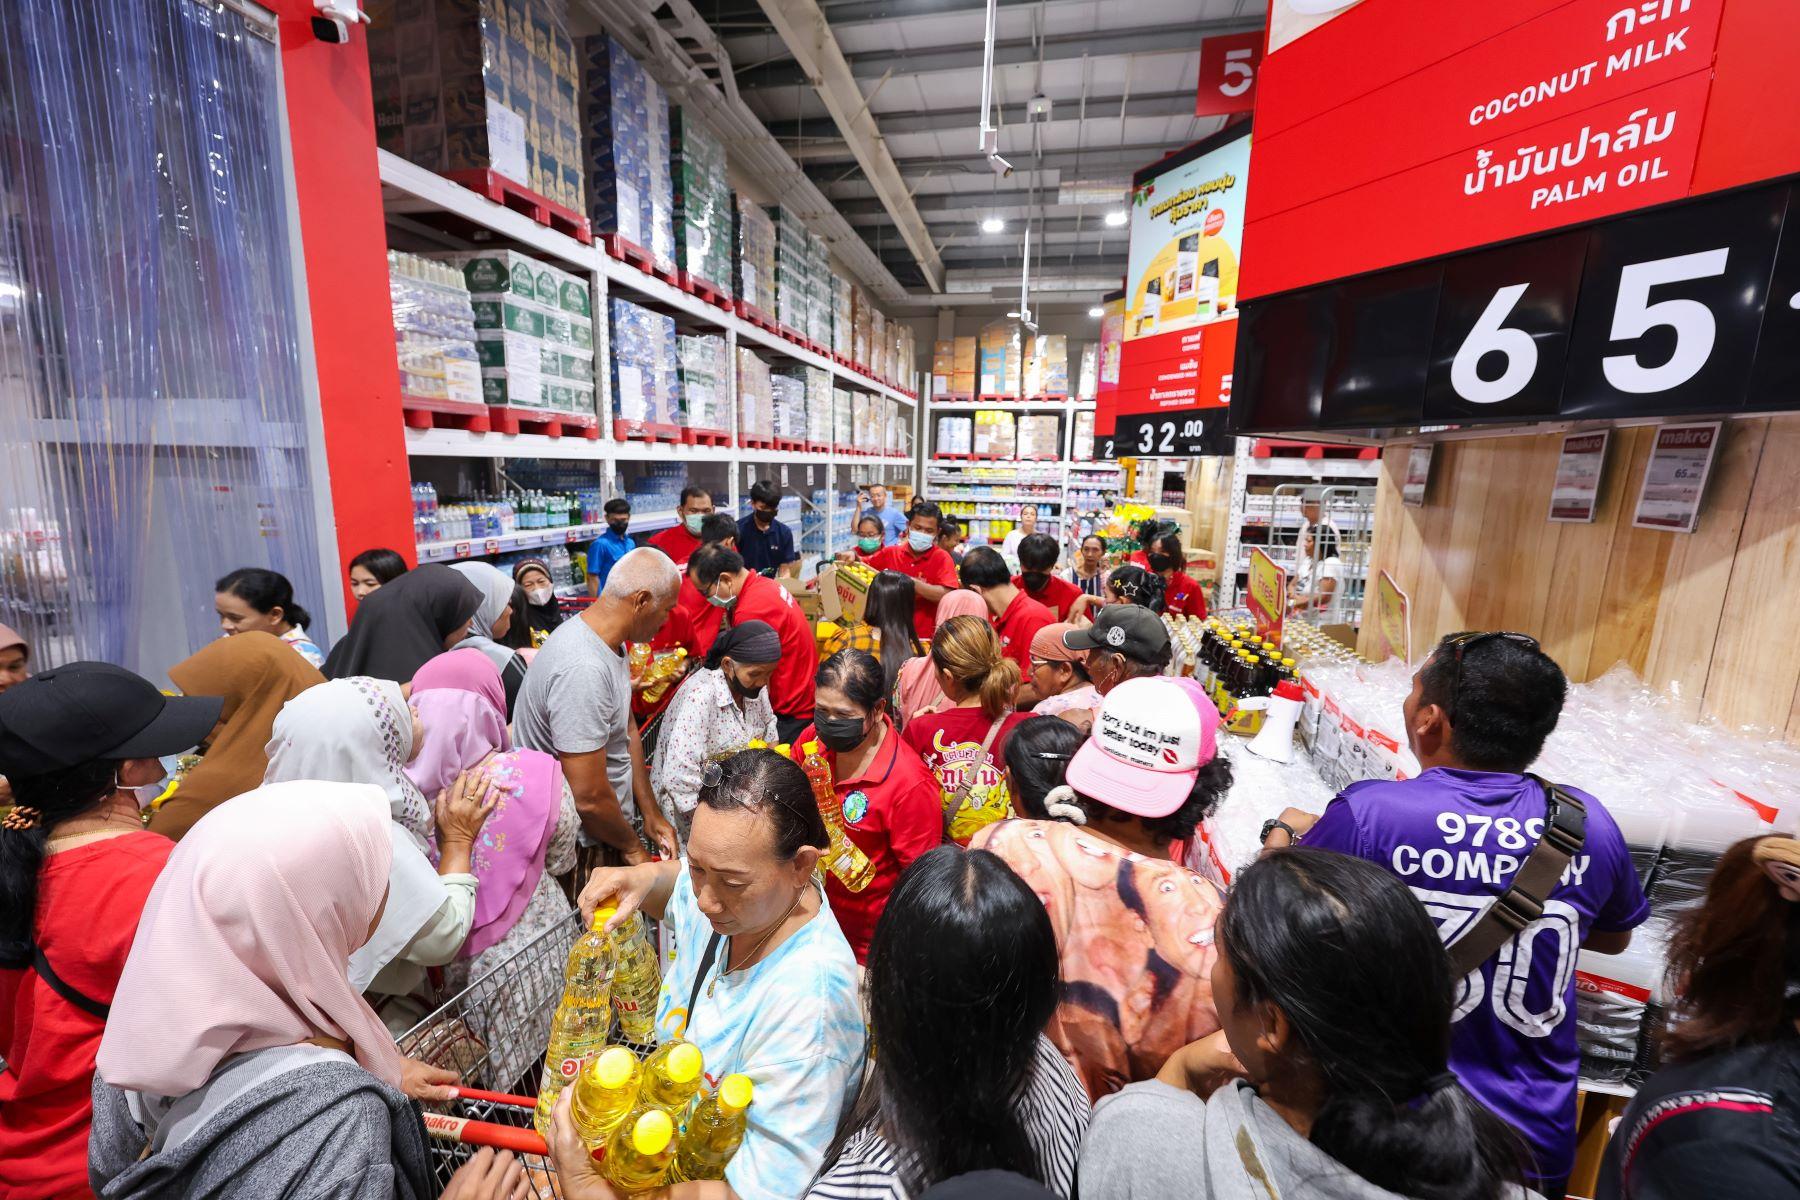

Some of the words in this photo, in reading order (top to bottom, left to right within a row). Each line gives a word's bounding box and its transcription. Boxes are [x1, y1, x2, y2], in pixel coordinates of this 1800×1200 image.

[1220, 49, 1253, 97] 5
[1469, 61, 1597, 126] COCONUT
[1606, 26, 1690, 77] MILK
[1464, 108, 1676, 195] น้ำมันปาล์ม
[1531, 172, 1607, 209] PALM
[1617, 157, 1669, 188] OIL
[1567, 438, 1601, 451] makro
[1661, 430, 1710, 444] makro
[1103, 726, 1127, 743] better
[1129, 738, 1161, 757] today
[1124, 720, 1140, 735] but
[1159, 731, 1181, 746] just
